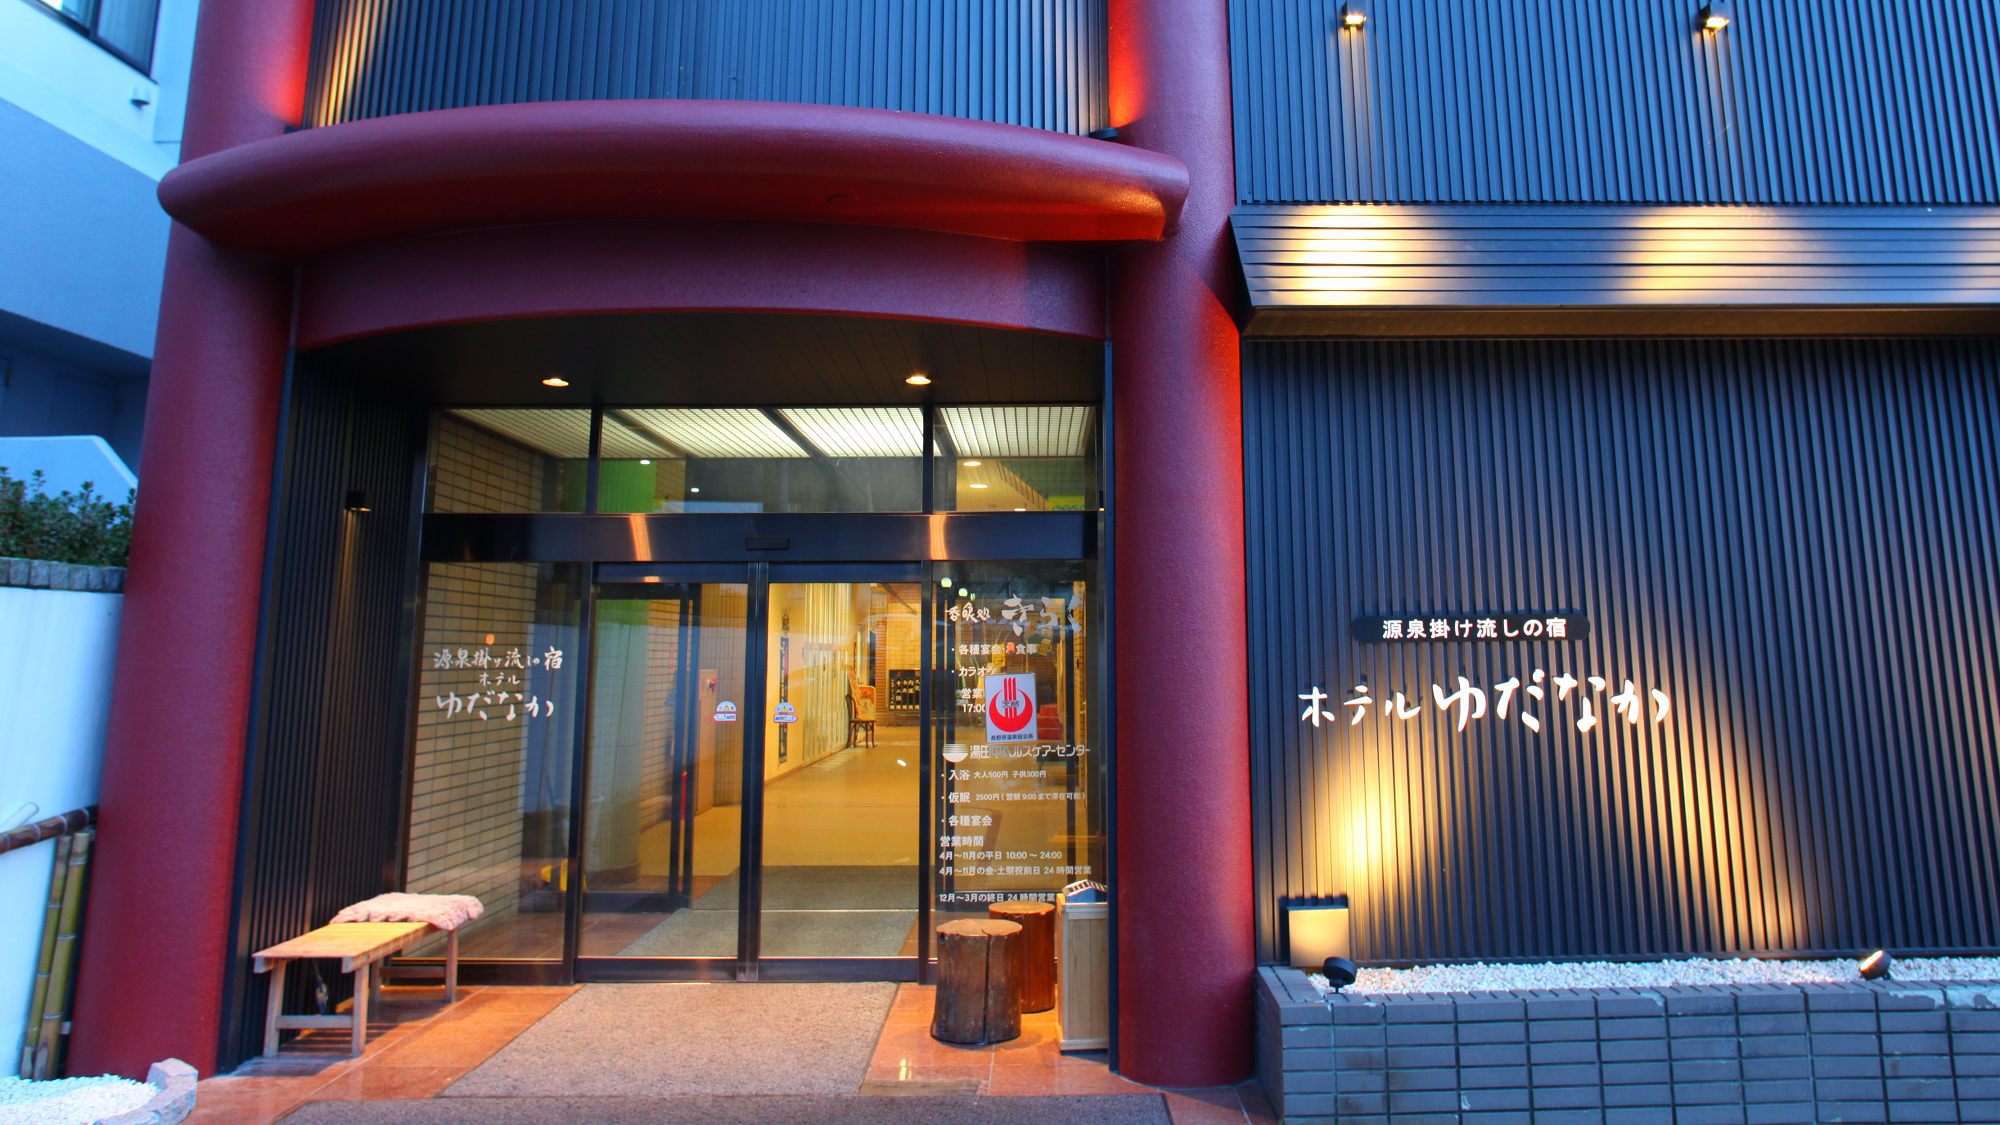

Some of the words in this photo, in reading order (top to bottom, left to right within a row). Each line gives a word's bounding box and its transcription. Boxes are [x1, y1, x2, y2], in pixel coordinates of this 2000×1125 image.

[1382, 617, 1568, 640] 源泉掛け流しの宿
[480, 672, 520, 687] ホテル
[436, 690, 554, 721] ゆだなか
[1298, 686, 1421, 727] ホテル
[1432, 668, 1670, 733] ゆだなか
[948, 770, 970, 781] 入浴
[974, 770, 1009, 778] 大人500円
[948, 792, 971, 803] 仮眠
[948, 815, 993, 826] 各種宴会
[939, 836, 984, 847] 営業時間
